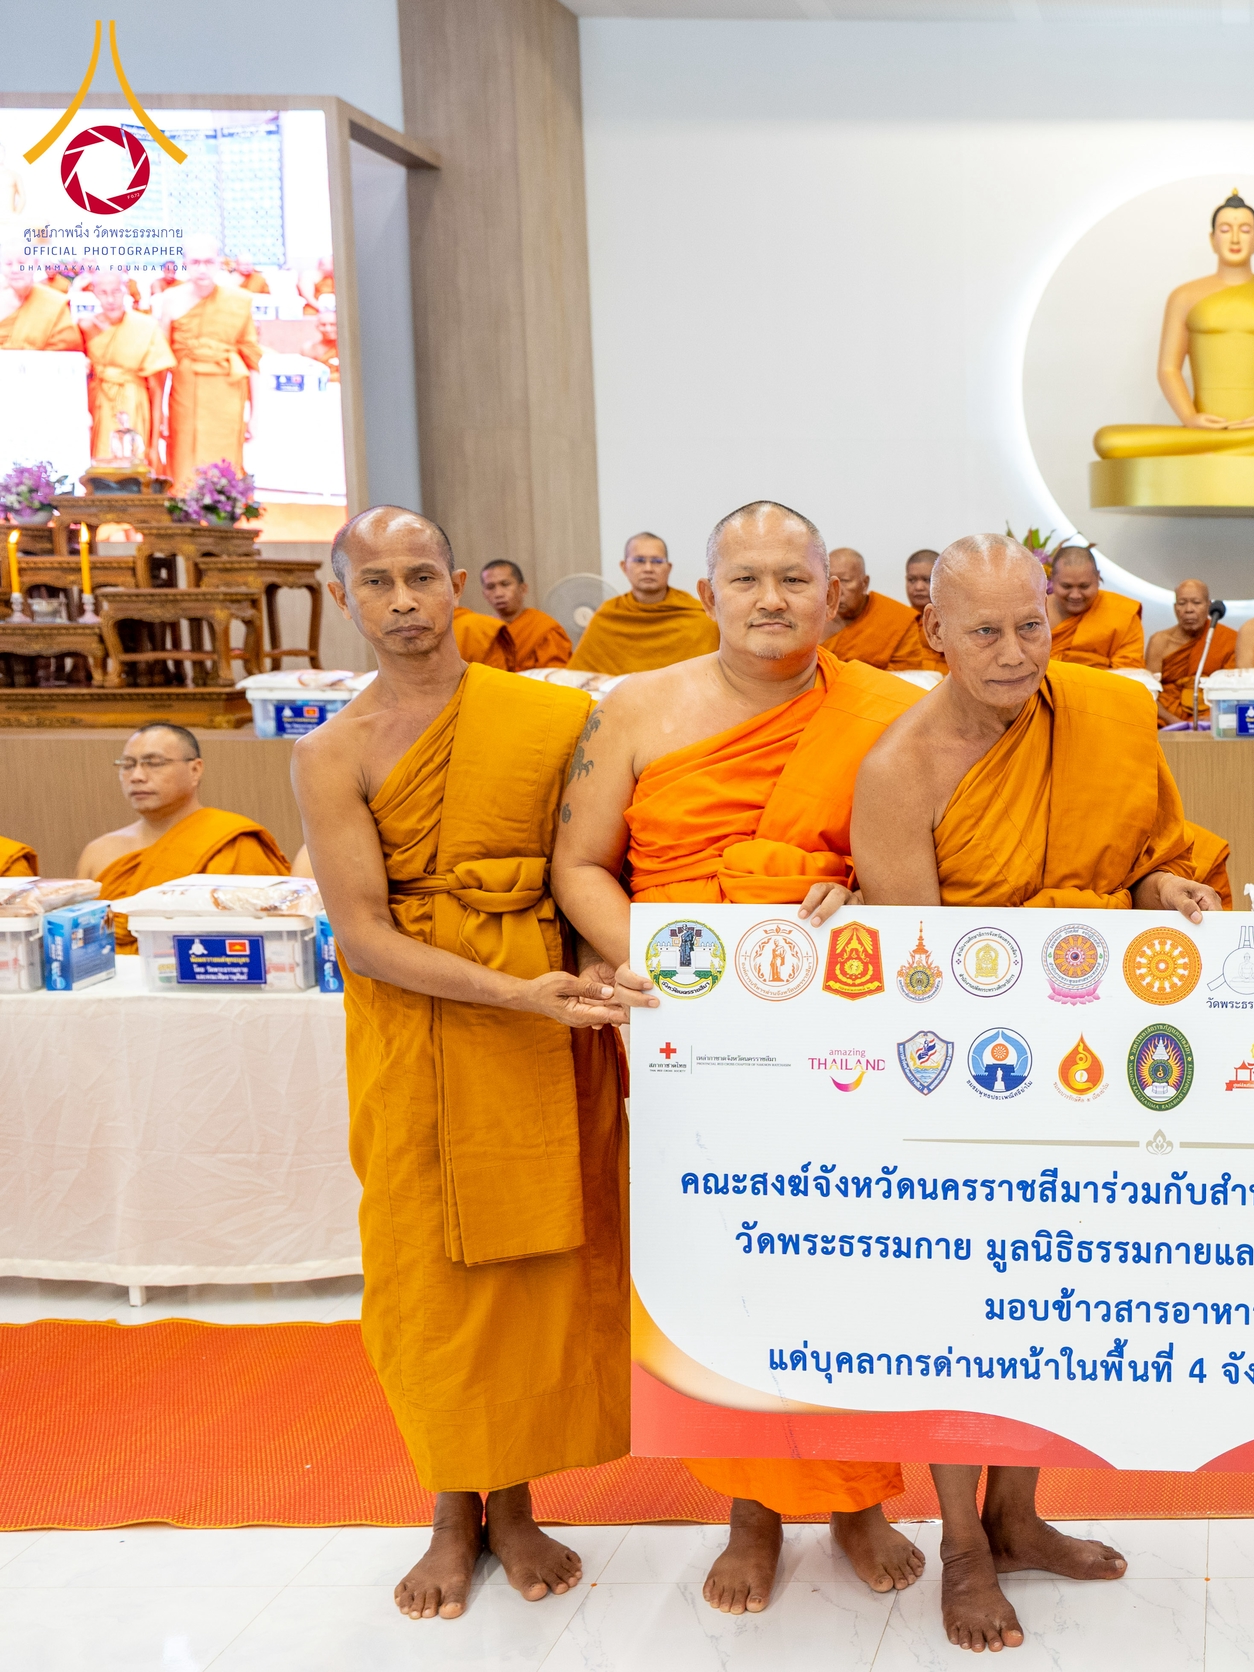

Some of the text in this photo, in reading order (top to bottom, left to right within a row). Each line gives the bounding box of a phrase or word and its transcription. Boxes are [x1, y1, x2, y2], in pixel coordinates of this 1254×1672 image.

[808, 1058, 885, 1071] THAILAND
[829, 1048, 866, 1058] amazing
[736, 1221, 971, 1261] วัดพระธรรมกาย
[769, 1337, 1175, 1384] แด่บุคลากรด่านหน้าในพื้นที่
[1188, 1357, 1207, 1384] 4
